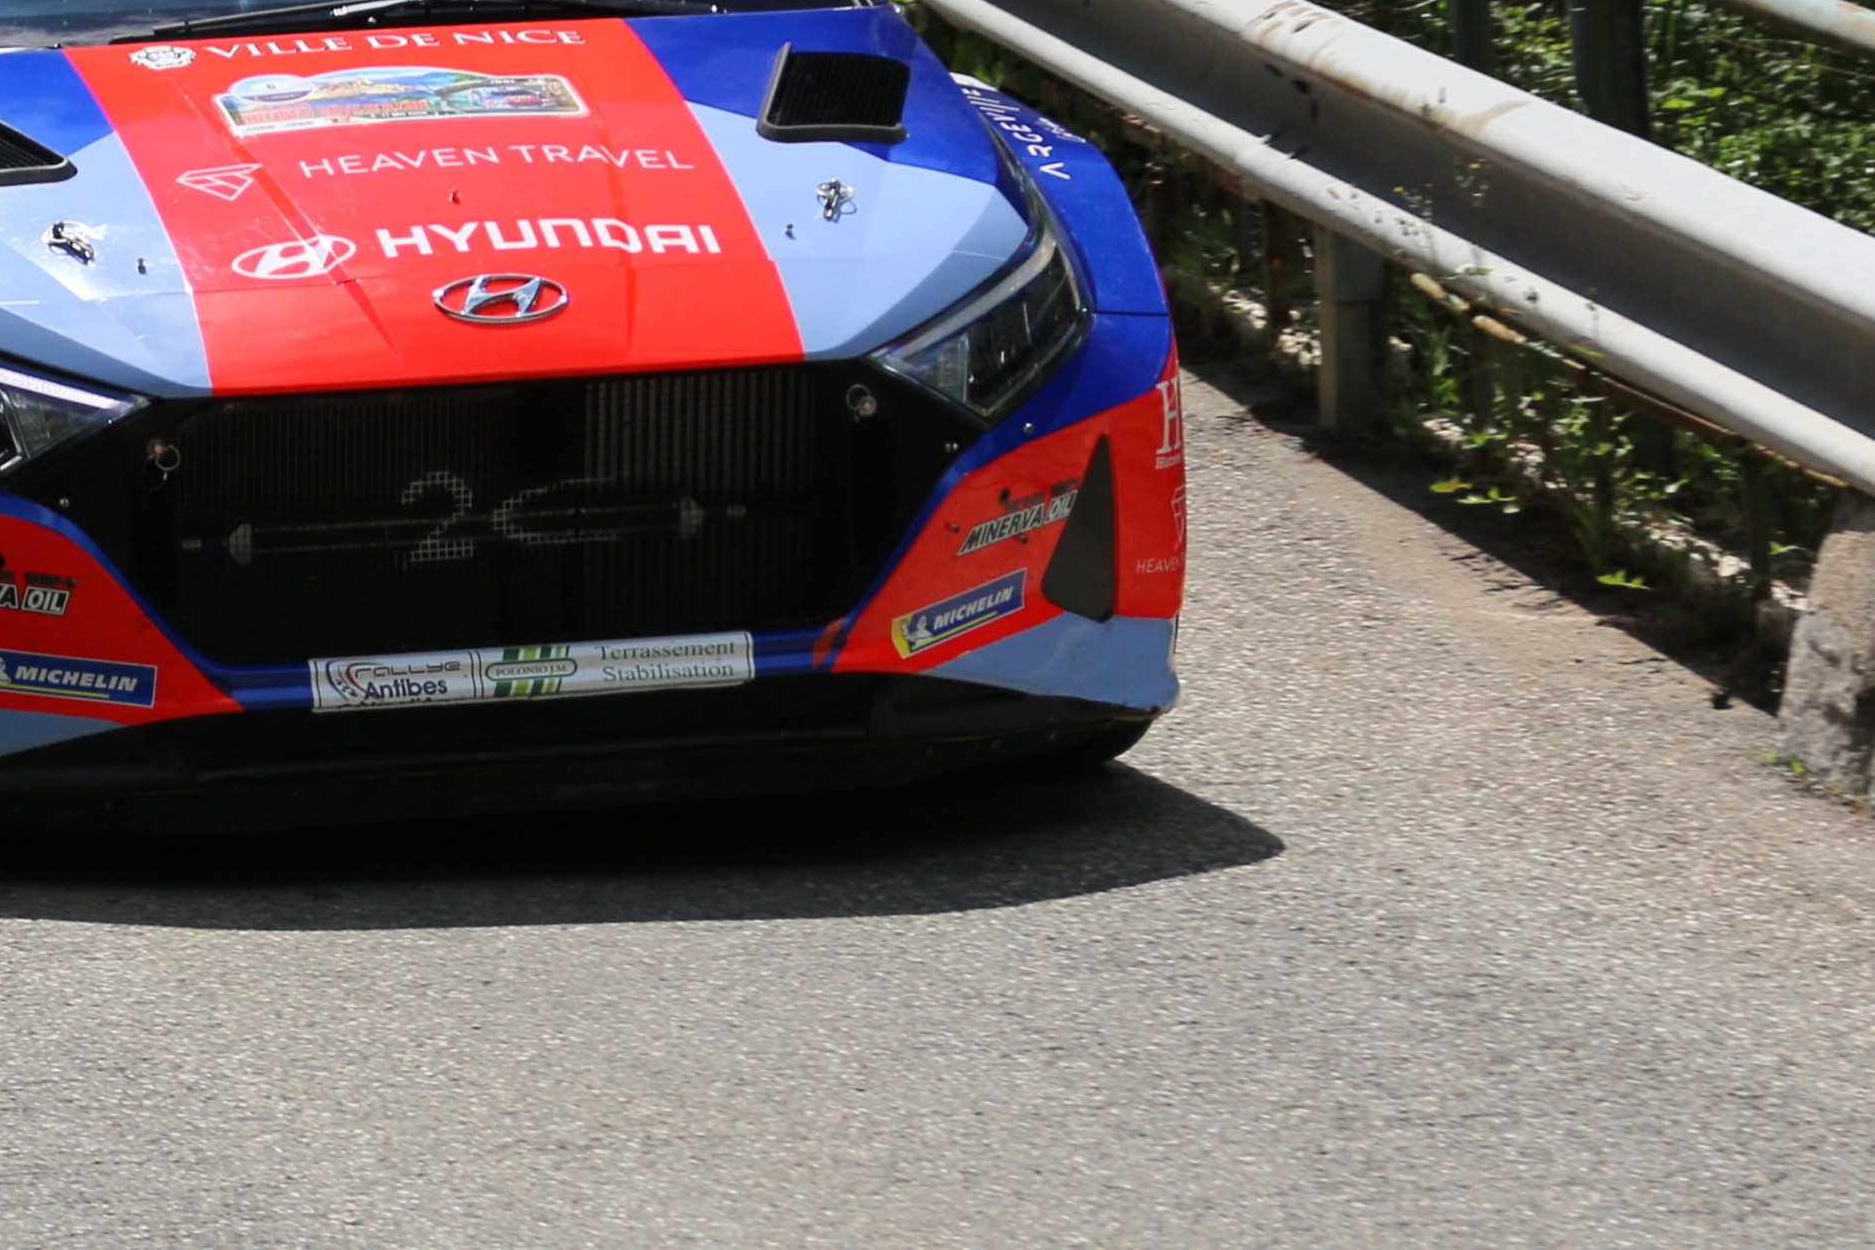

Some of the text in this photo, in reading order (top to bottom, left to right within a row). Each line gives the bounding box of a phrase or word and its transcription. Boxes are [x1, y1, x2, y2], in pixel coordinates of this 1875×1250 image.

[203, 29, 587, 58] VILLE DE NICE
[299, 145, 695, 178] HEAVEN TRAVEL
[375, 217, 722, 258] HYUNDAI
[957, 503, 1045, 556] MINERVA
[25, 588, 66, 612] OIL
[933, 586, 1014, 630] MICHELIN
[595, 640, 735, 661] Terrassement
[15, 665, 138, 692] MICHELIN
[496, 665, 547, 677] POLONIO
[603, 662, 734, 683] Stabilisation
[364, 678, 448, 700] Antibes
